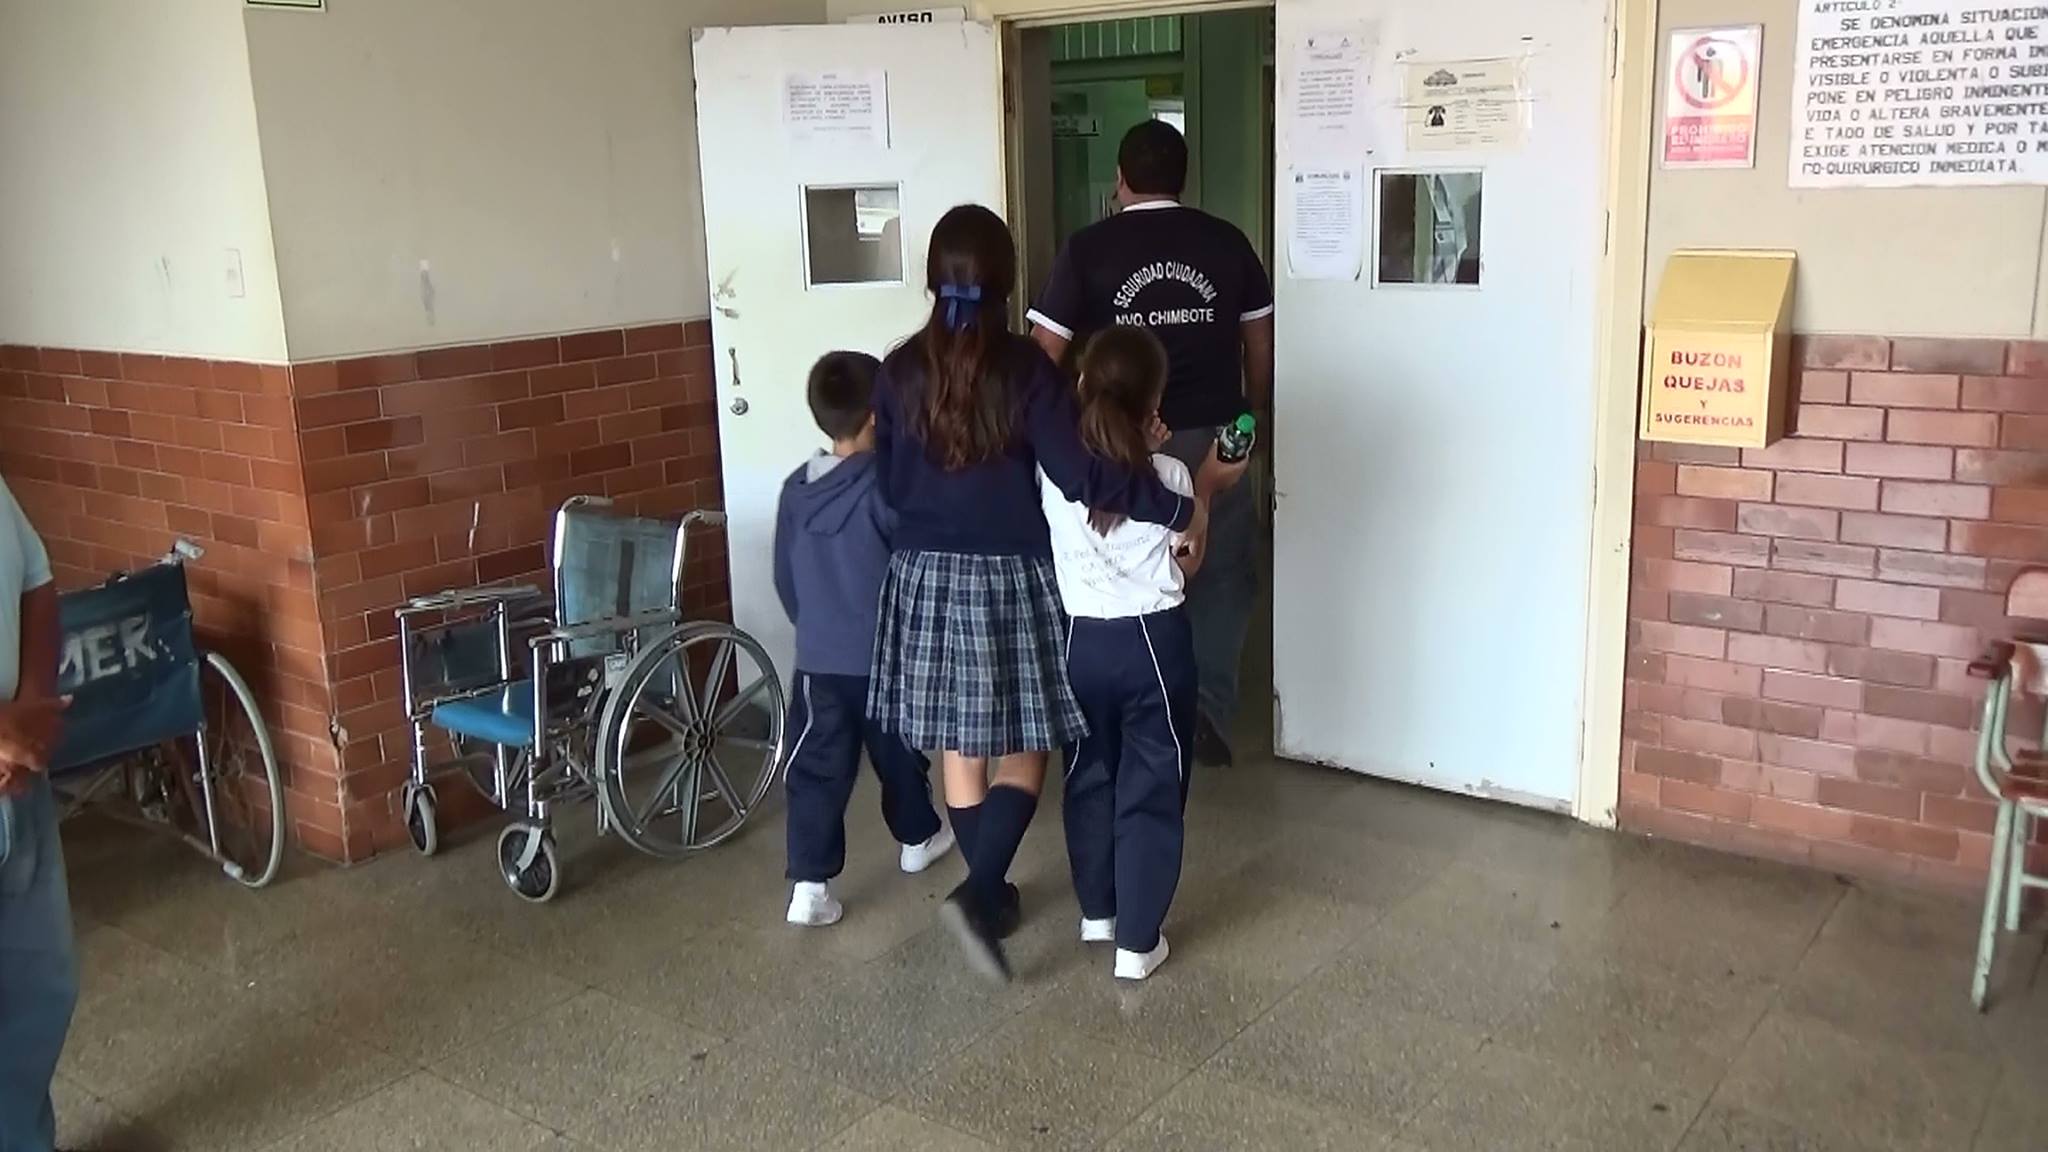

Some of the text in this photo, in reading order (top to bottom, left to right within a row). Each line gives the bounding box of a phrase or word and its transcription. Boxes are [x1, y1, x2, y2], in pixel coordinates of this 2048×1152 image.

[1814, 0, 1880, 13] ARTICULO
[1840, 18, 1861, 31] SE
[1870, 12, 1950, 30] DENOMINA
[1811, 25, 2039, 51] EMERGENCIA AQUELLA QUE
[1809, 51, 1922, 68] PRESENTARSE
[1932, 50, 1953, 63] EN
[1962, 46, 2017, 61] FORMA
[1809, 72, 1871, 87] VISIBLE
[1880, 71, 1890, 84] O
[1899, 67, 1979, 83] VIOLENTA
[1988, 66, 1999, 79] O
[1807, 90, 1847, 106] PONE
[1856, 90, 1876, 103] EN
[1884, 87, 1953, 102] PELIGRO
[1807, 103, 2048, 122] VIDA O ALTERA GRAVEMENTE
[1874, 126, 1895, 139] DE
[1903, 123, 1956, 138] SALUD
[1967, 123, 1975, 136] Y
[1985, 122, 2018, 136] POR
[1803, 145, 1850, 158] EXIGE
[1859, 142, 1937, 157] ATENCION
[1946, 140, 2006, 155] MEDICA
[2016, 140, 2027, 153] O
[1113, 260, 1217, 309] SEGURIDAD CIUDADANA
[1116, 308, 1215, 327] NVO. CHIMBOTE
[1671, 351, 1742, 369] BUZON
[1663, 375, 1745, 393] QUEJAS
[1700, 399, 1708, 409] Y
[1655, 412, 1753, 428] SUGERENCIAS
